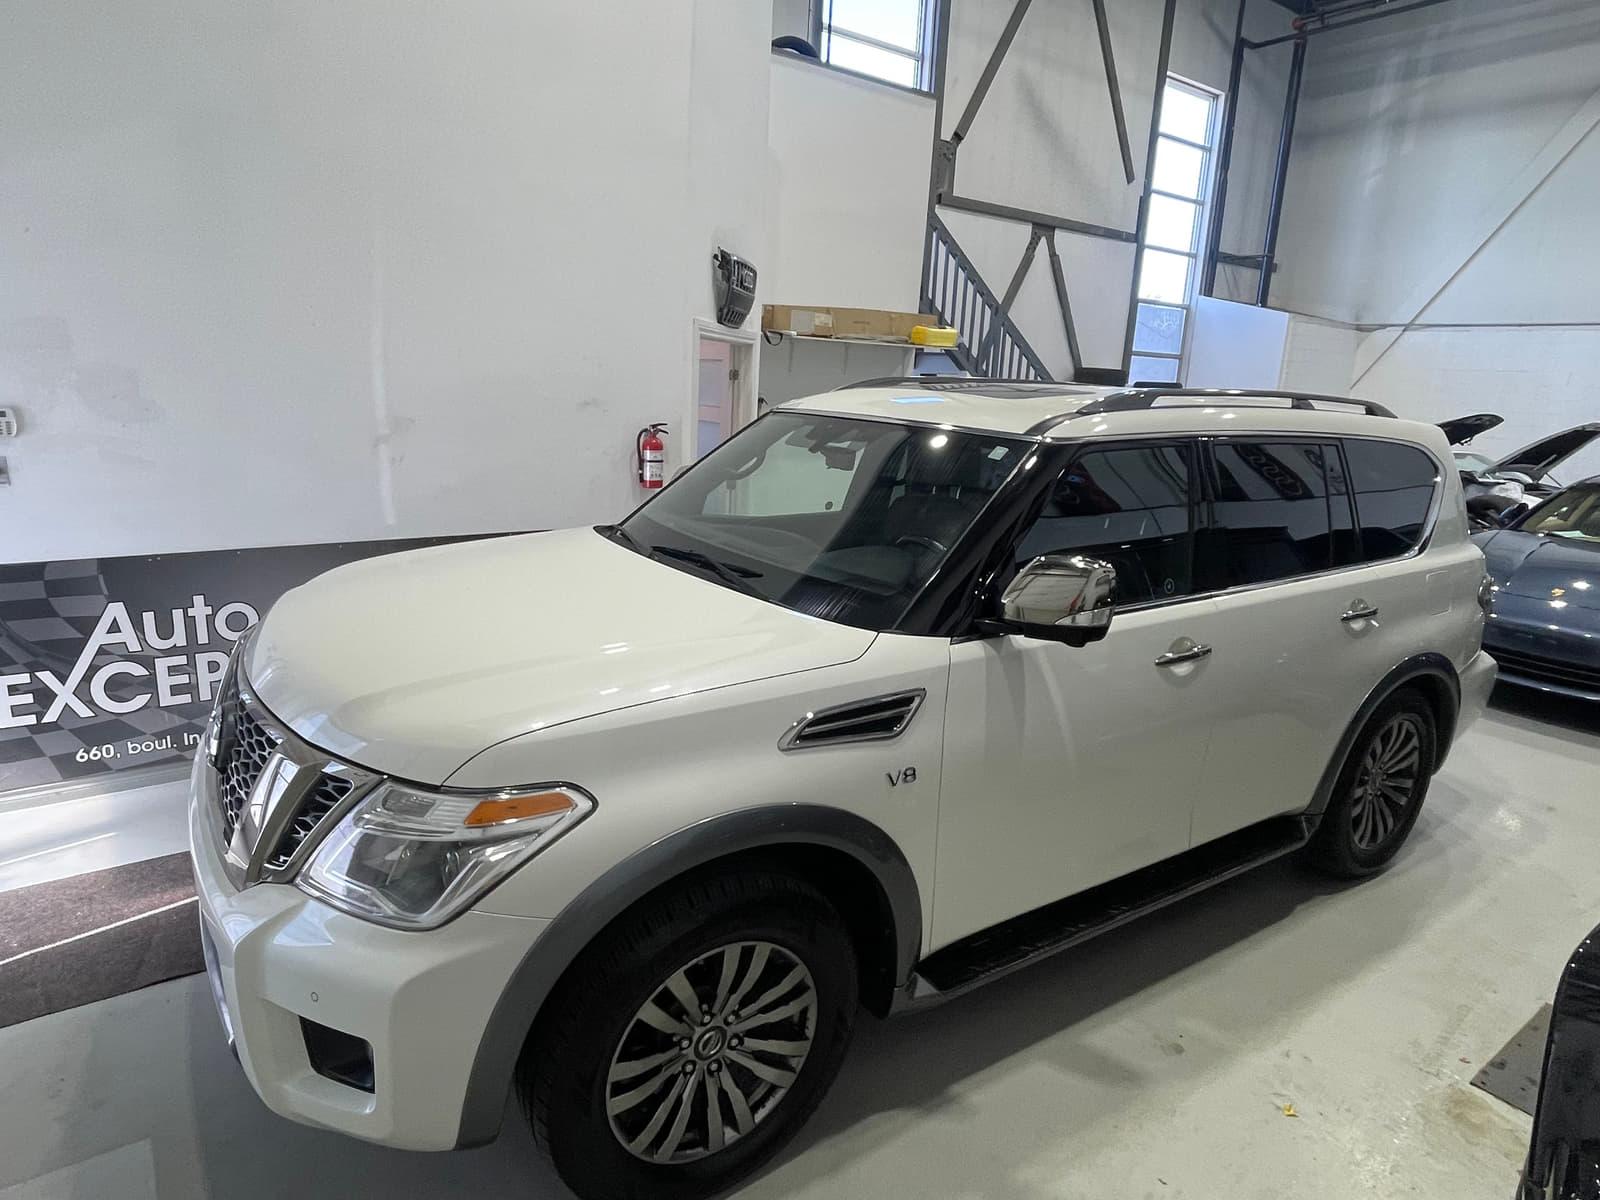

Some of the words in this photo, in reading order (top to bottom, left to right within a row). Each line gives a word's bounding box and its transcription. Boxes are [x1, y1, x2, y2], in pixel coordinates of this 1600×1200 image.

[86, 594, 260, 653] Auto
[75, 743, 121, 763] 660,
[127, 735, 178, 755] boul.
[886, 766, 917, 787] V8
